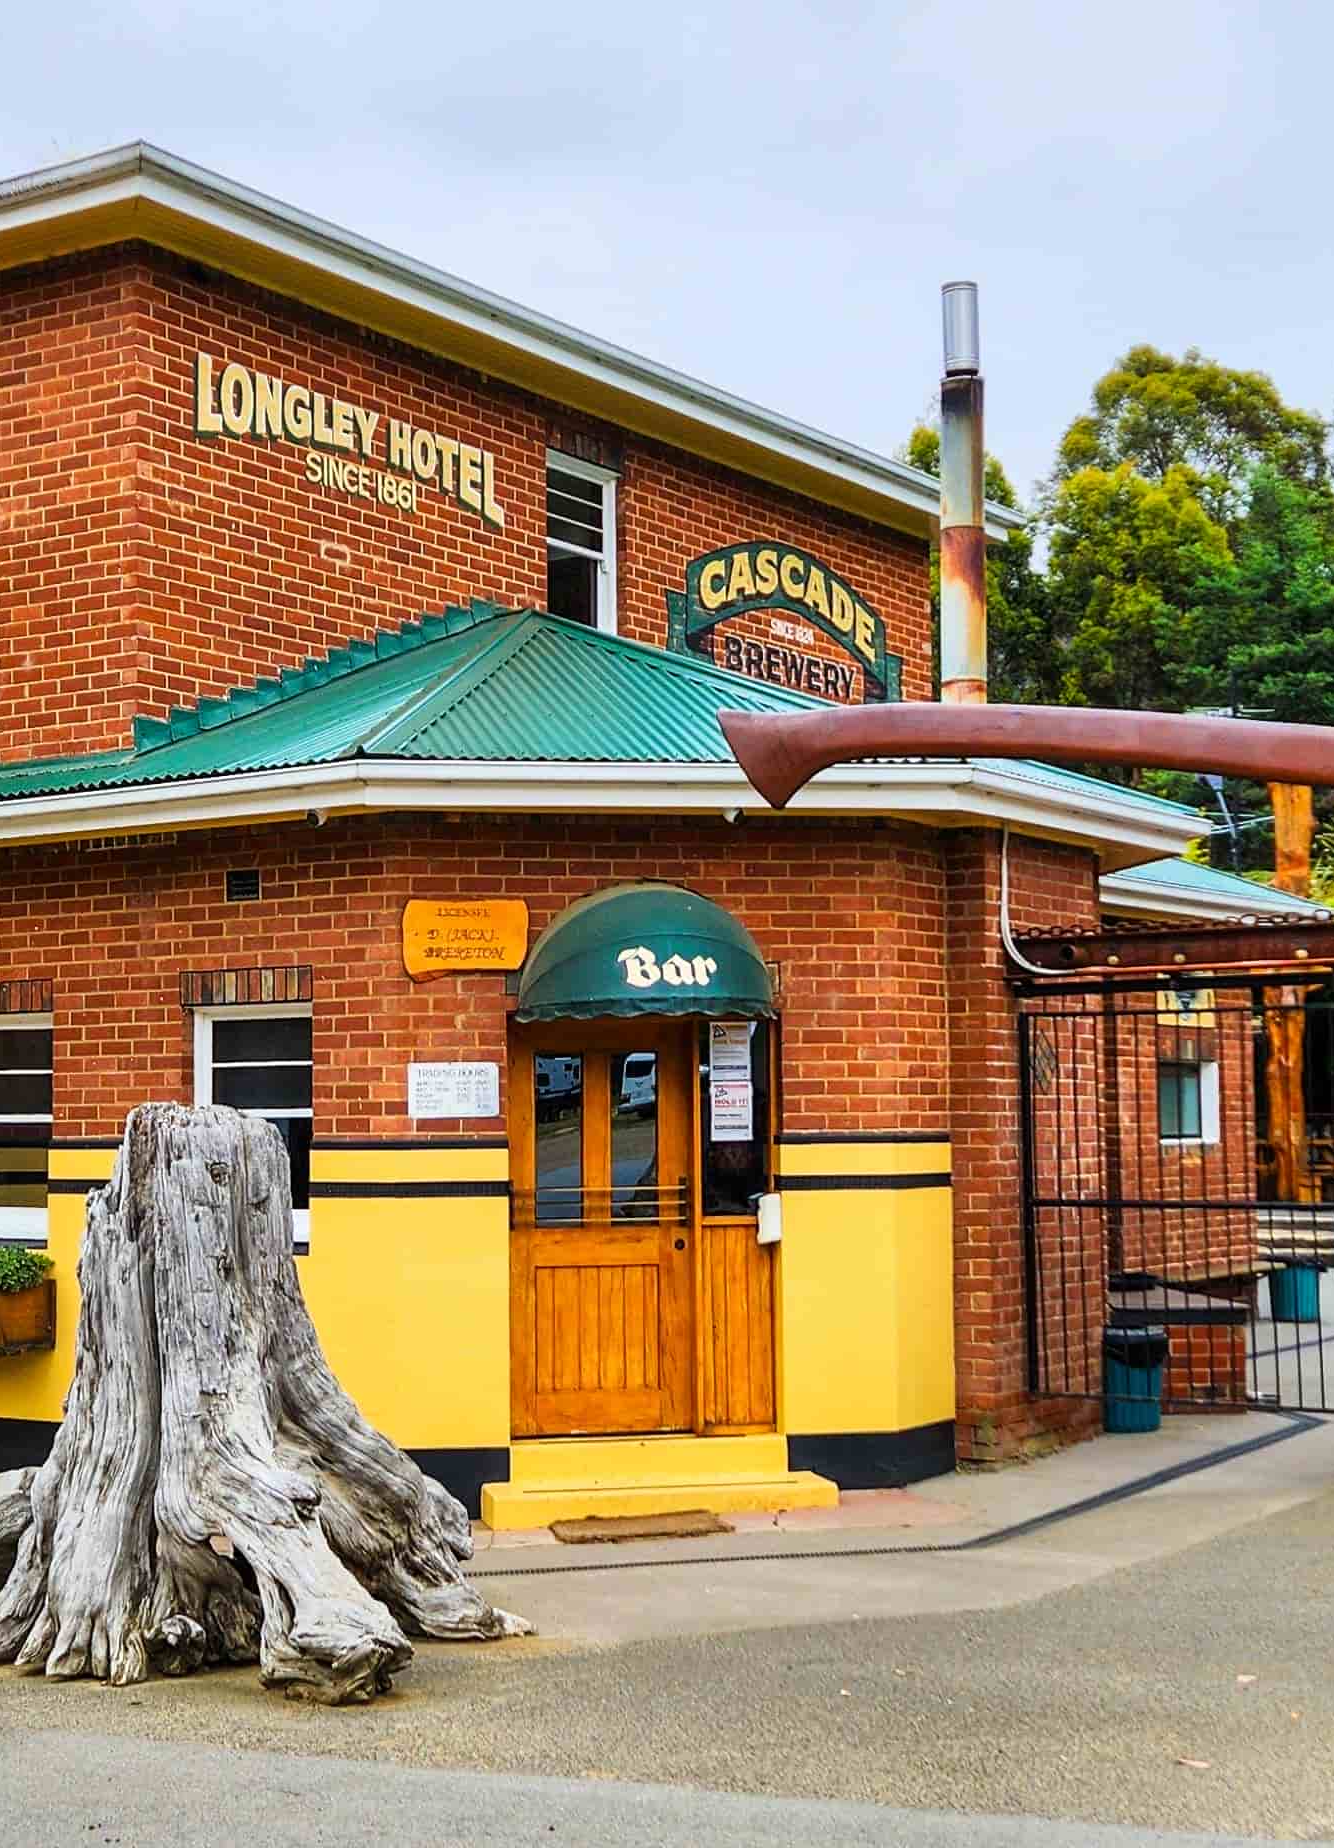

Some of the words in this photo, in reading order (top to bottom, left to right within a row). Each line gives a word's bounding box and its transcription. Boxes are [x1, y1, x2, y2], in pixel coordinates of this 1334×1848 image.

[195, 352, 379, 457] LONGLEY
[388, 418, 505, 528] HOTEL
[305, 452, 370, 499] SINCE
[376, 471, 417, 513] 1861
[699, 550, 876, 664] CASCADE
[771, 618, 795, 640] SINCE
[724, 634, 857, 700] BREWERY
[617, 946, 718, 989] Bar
